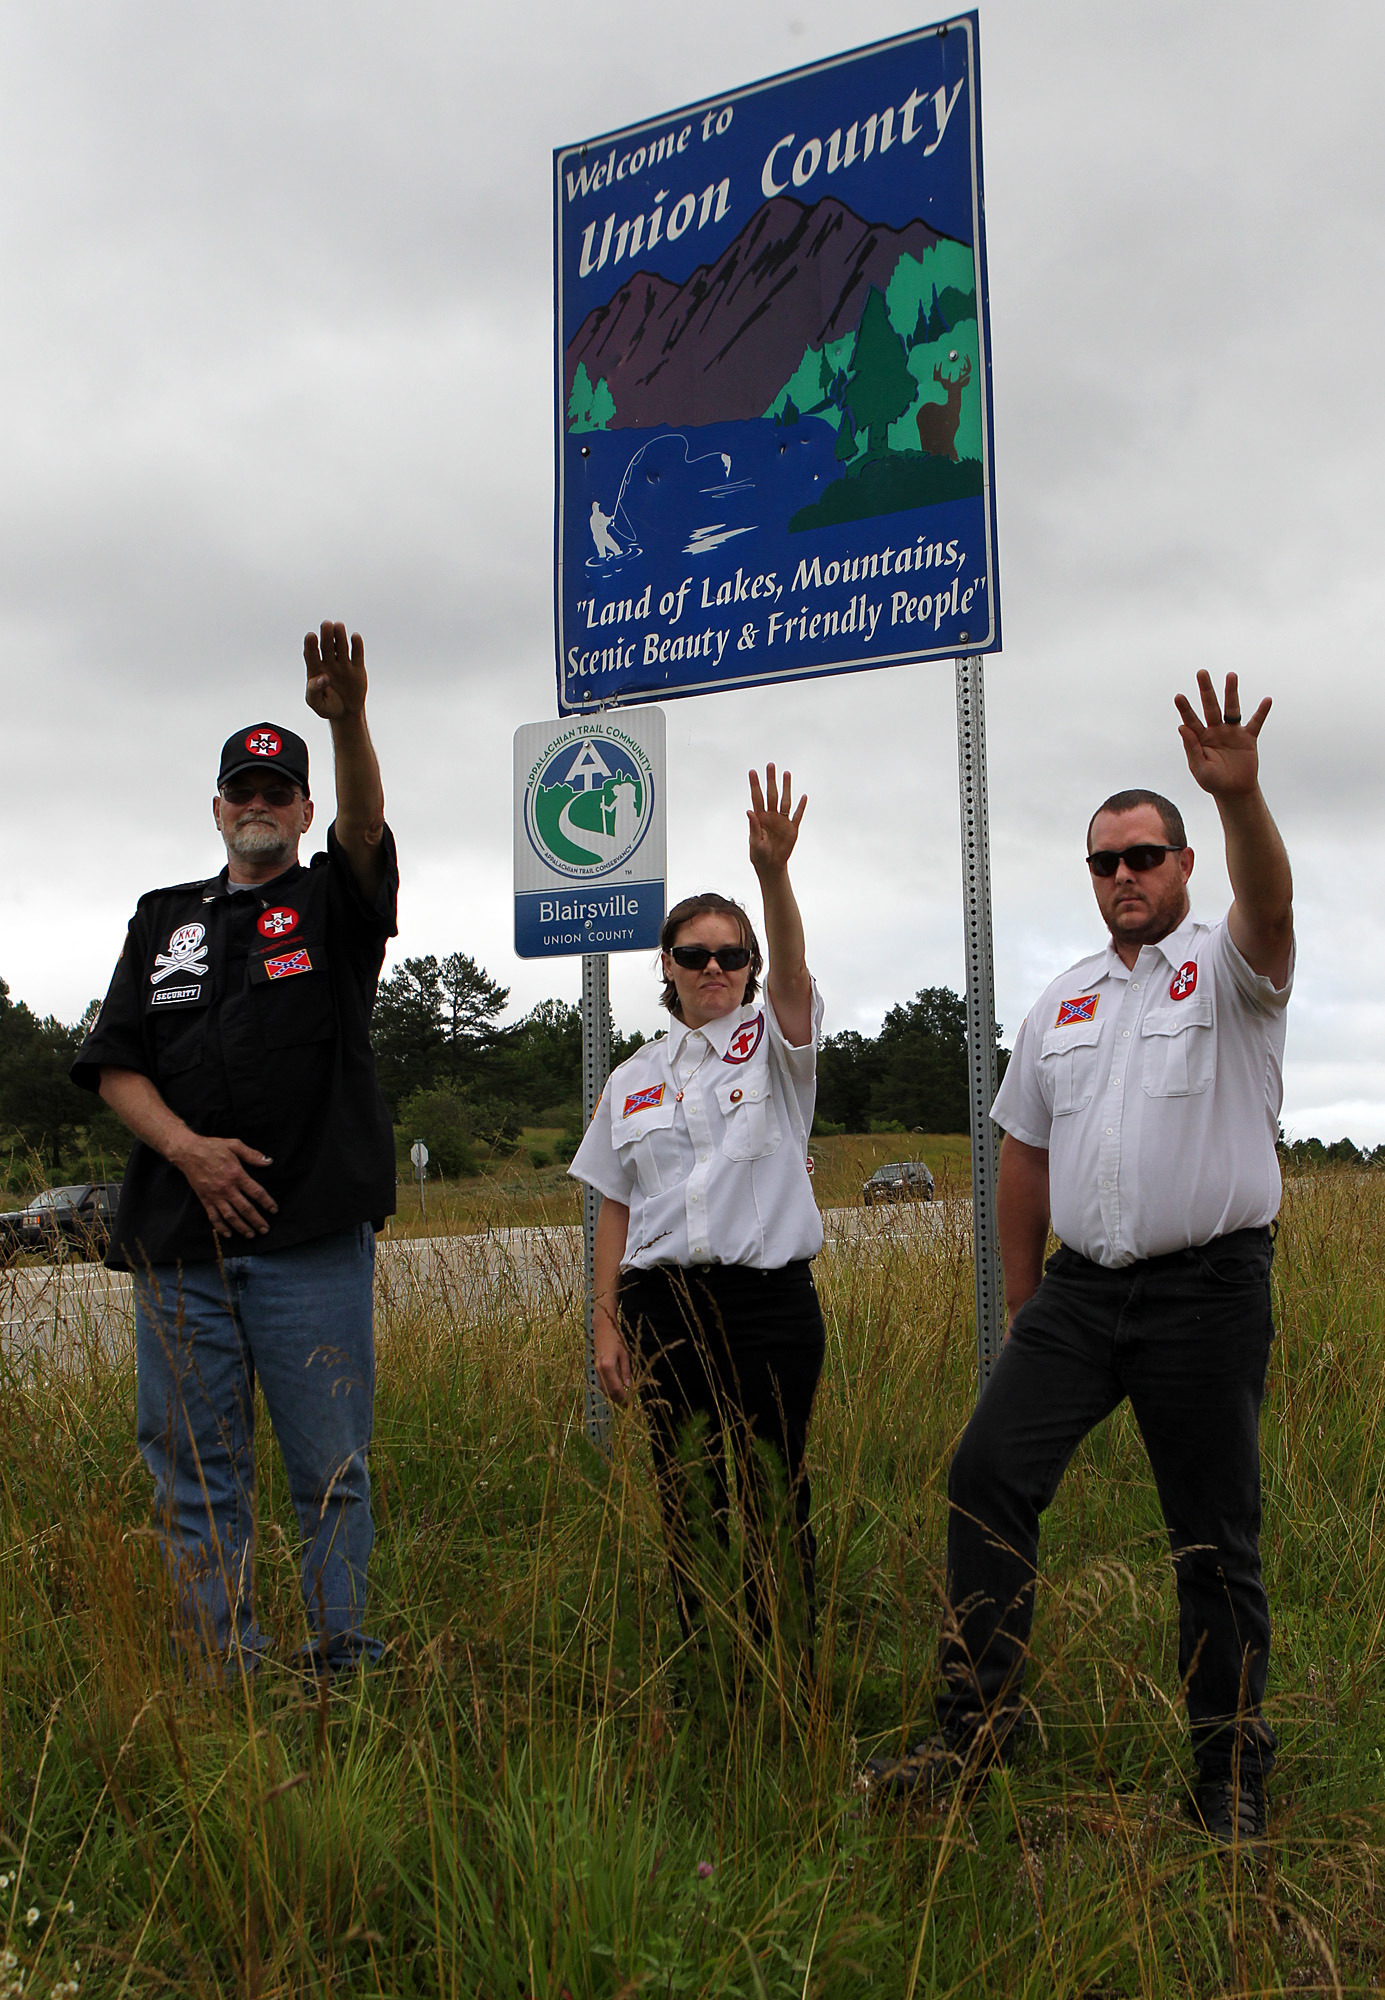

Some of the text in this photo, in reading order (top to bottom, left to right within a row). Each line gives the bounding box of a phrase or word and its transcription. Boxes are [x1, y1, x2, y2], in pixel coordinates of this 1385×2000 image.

[565, 106, 734, 202] Welcome to
[579, 77, 965, 278] Union County
[576, 535, 966, 629] "Land of Lakes, Mountains,
[567, 576, 986, 679] Scenic Beauty & Friendly People"
[527, 724, 652, 788] APPALACHIAN TRAIL COMMUNITY
[544, 852, 578, 874] APPALACHIAN
[595, 844, 632, 872] CONSERVANCY
[540, 894, 639, 922] Blairsville
[178, 928, 198, 940] KKK
[543, 929, 634, 945] UNION COUNTY
[156, 988, 197, 1001] SECURITY
